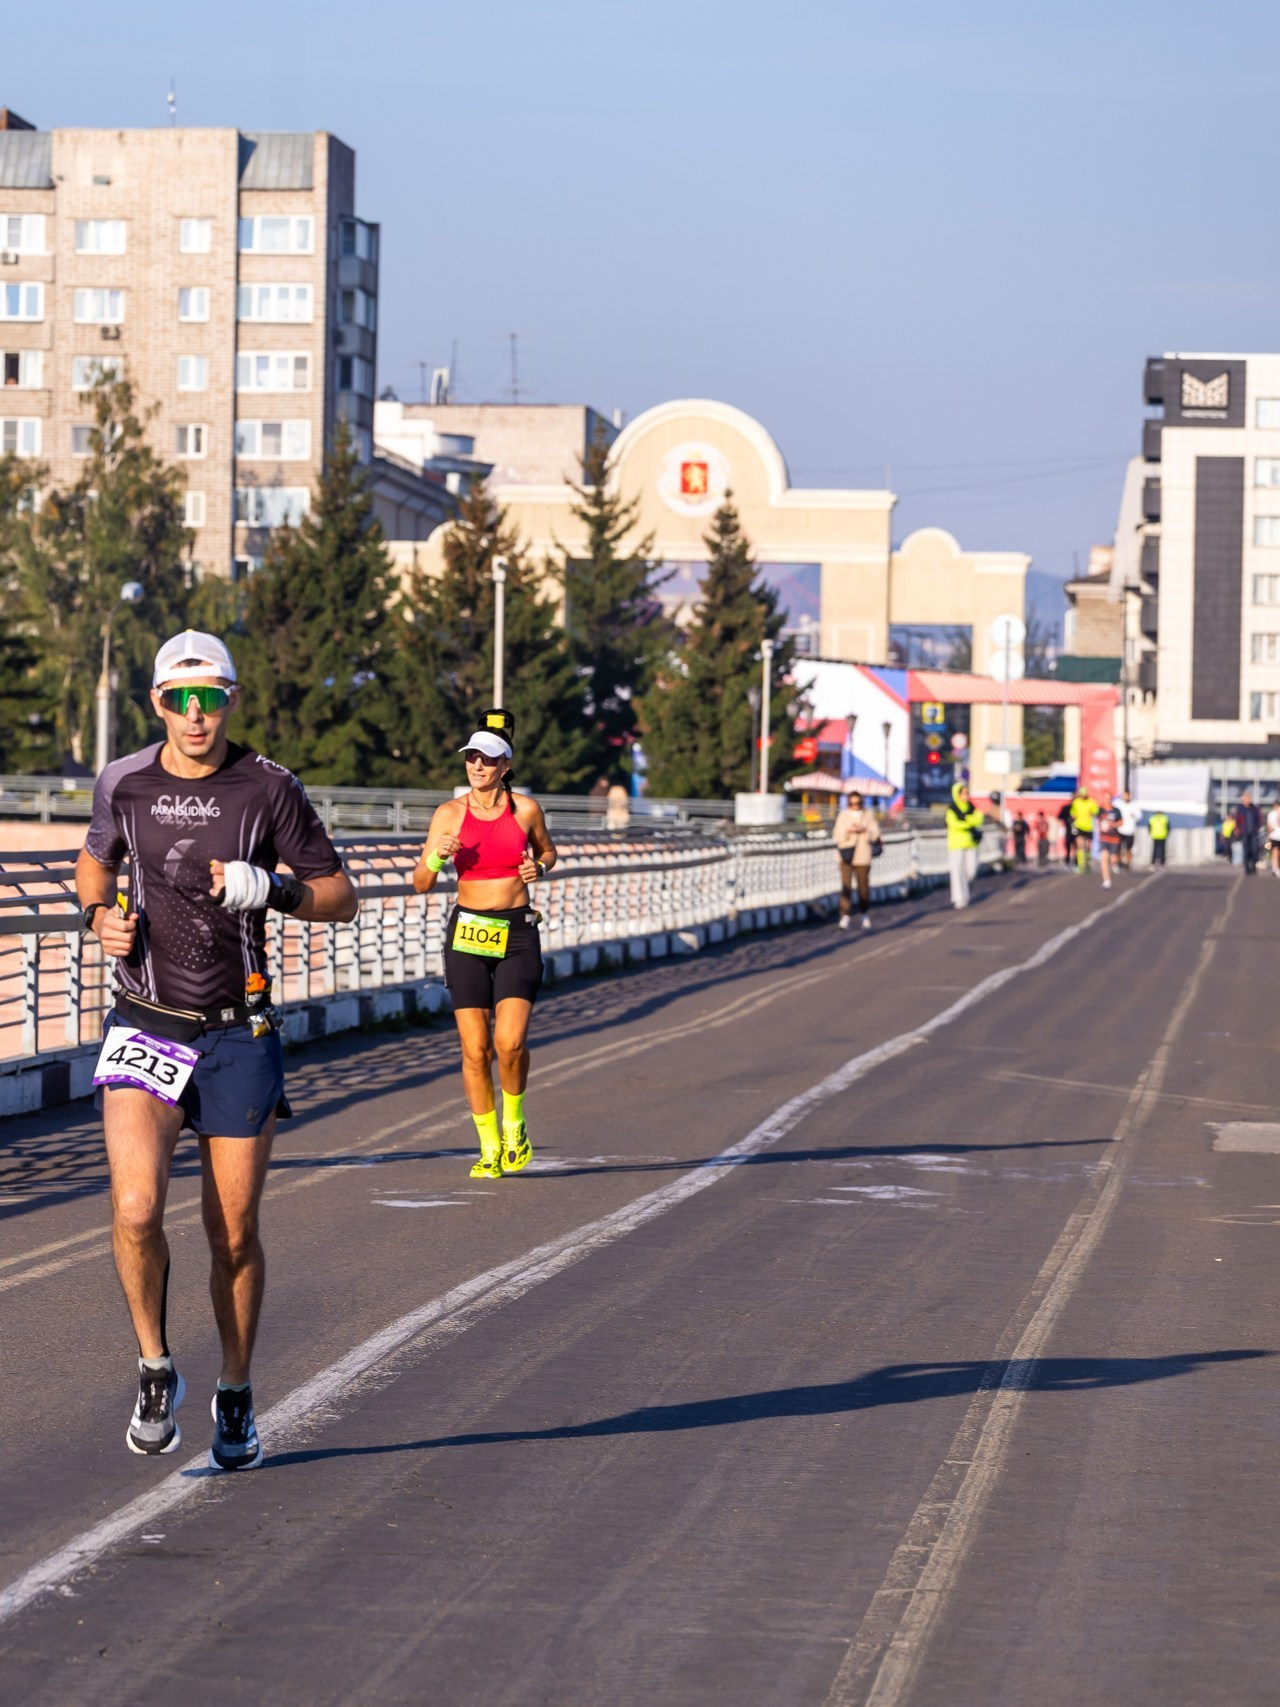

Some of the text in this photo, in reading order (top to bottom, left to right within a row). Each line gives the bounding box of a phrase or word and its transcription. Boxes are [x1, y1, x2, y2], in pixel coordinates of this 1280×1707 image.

[151, 805, 221, 817] PARAGLIDING
[460, 926, 501, 945] 1104
[106, 1045, 179, 1086] 4213
